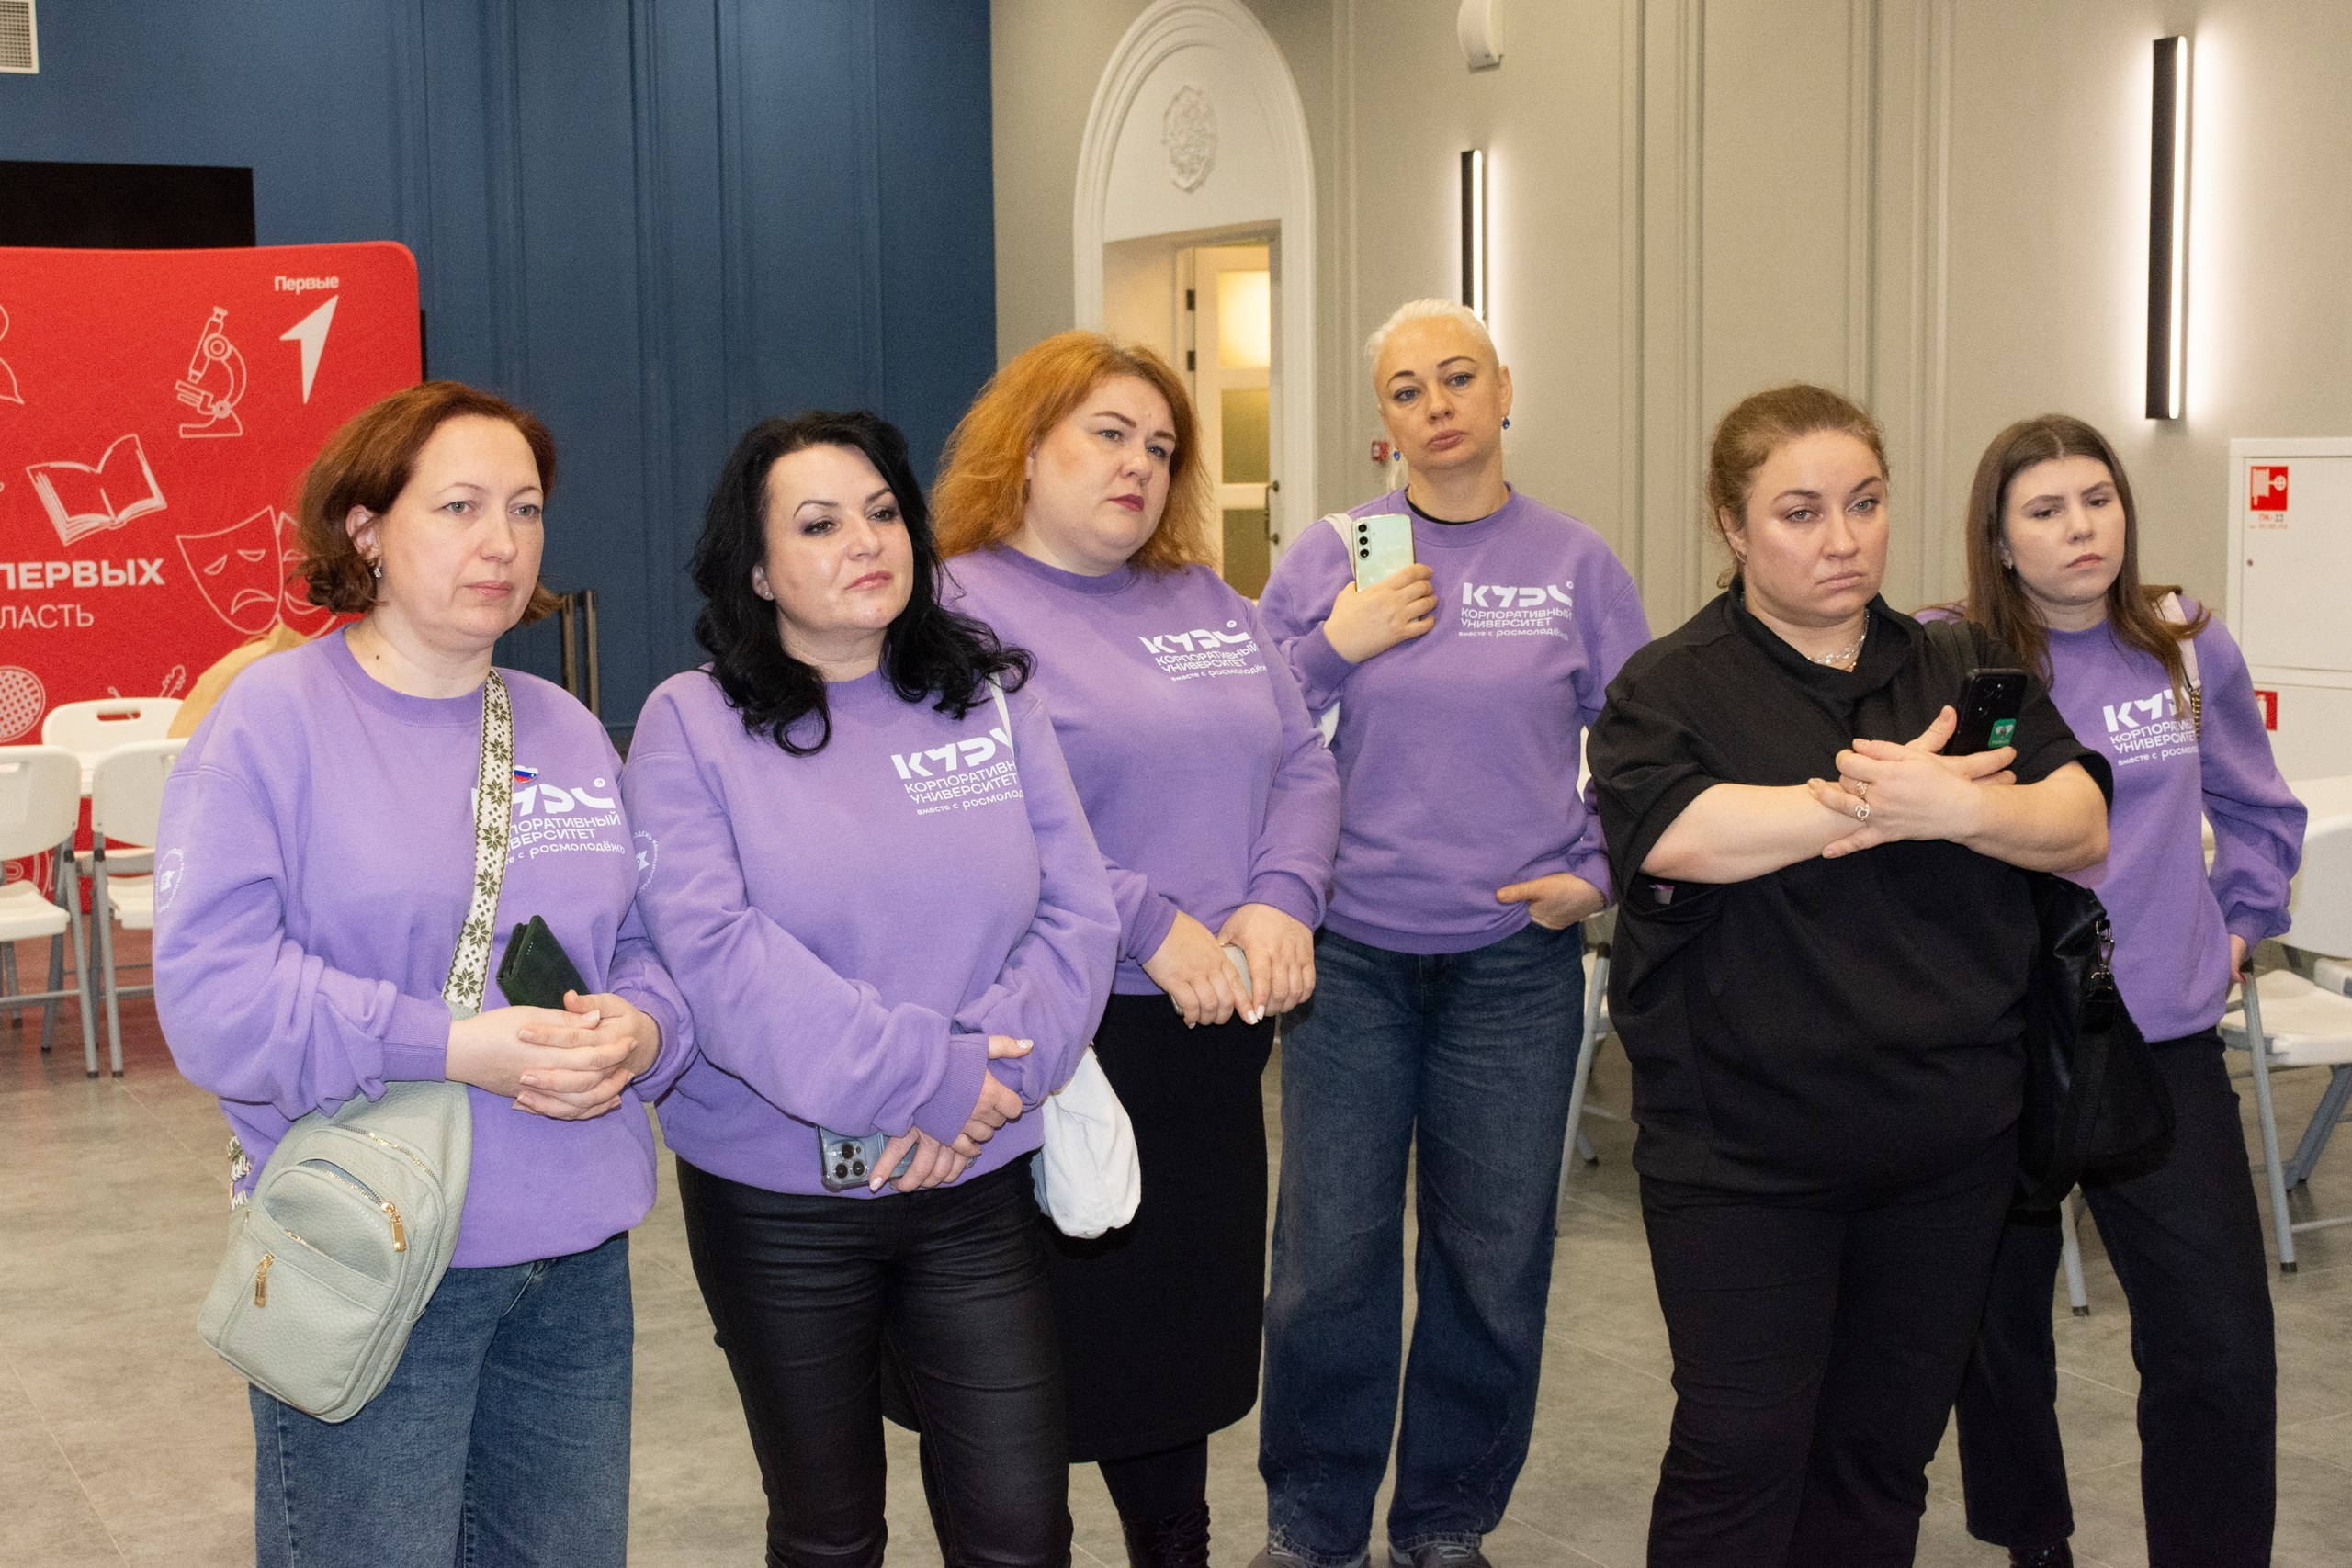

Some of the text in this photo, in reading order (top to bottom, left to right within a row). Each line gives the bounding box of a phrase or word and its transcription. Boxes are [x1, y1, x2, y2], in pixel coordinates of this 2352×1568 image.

[275, 275, 339, 295] Первые
[1461, 608, 1572, 621] КОРПОРАТИВНЫЙ
[1461, 617, 1552, 628] УНИВЕРСИТЕТ
[1155, 641, 1260, 666] КОРПОРАТИВНЫЙ
[1161, 658, 1247, 673] УНИВЕРСИТЕТ
[1170, 672, 1200, 682] вместе
[1208, 664, 1268, 677] росмолодёж
[2118, 754, 2150, 766] вместе
[904, 760, 1017, 794] КОРПОРАТИВН
[910, 773, 1018, 804] УНИВЕРСИТЕТ
[917, 805, 951, 816] вместе
[963, 790, 1024, 811] росмолод
[511, 811, 621, 834] ПОРАТИВНЫЙ
[509, 829, 595, 850] ВЕРСИТЕТ
[530, 841, 625, 860] росмолодёжь
